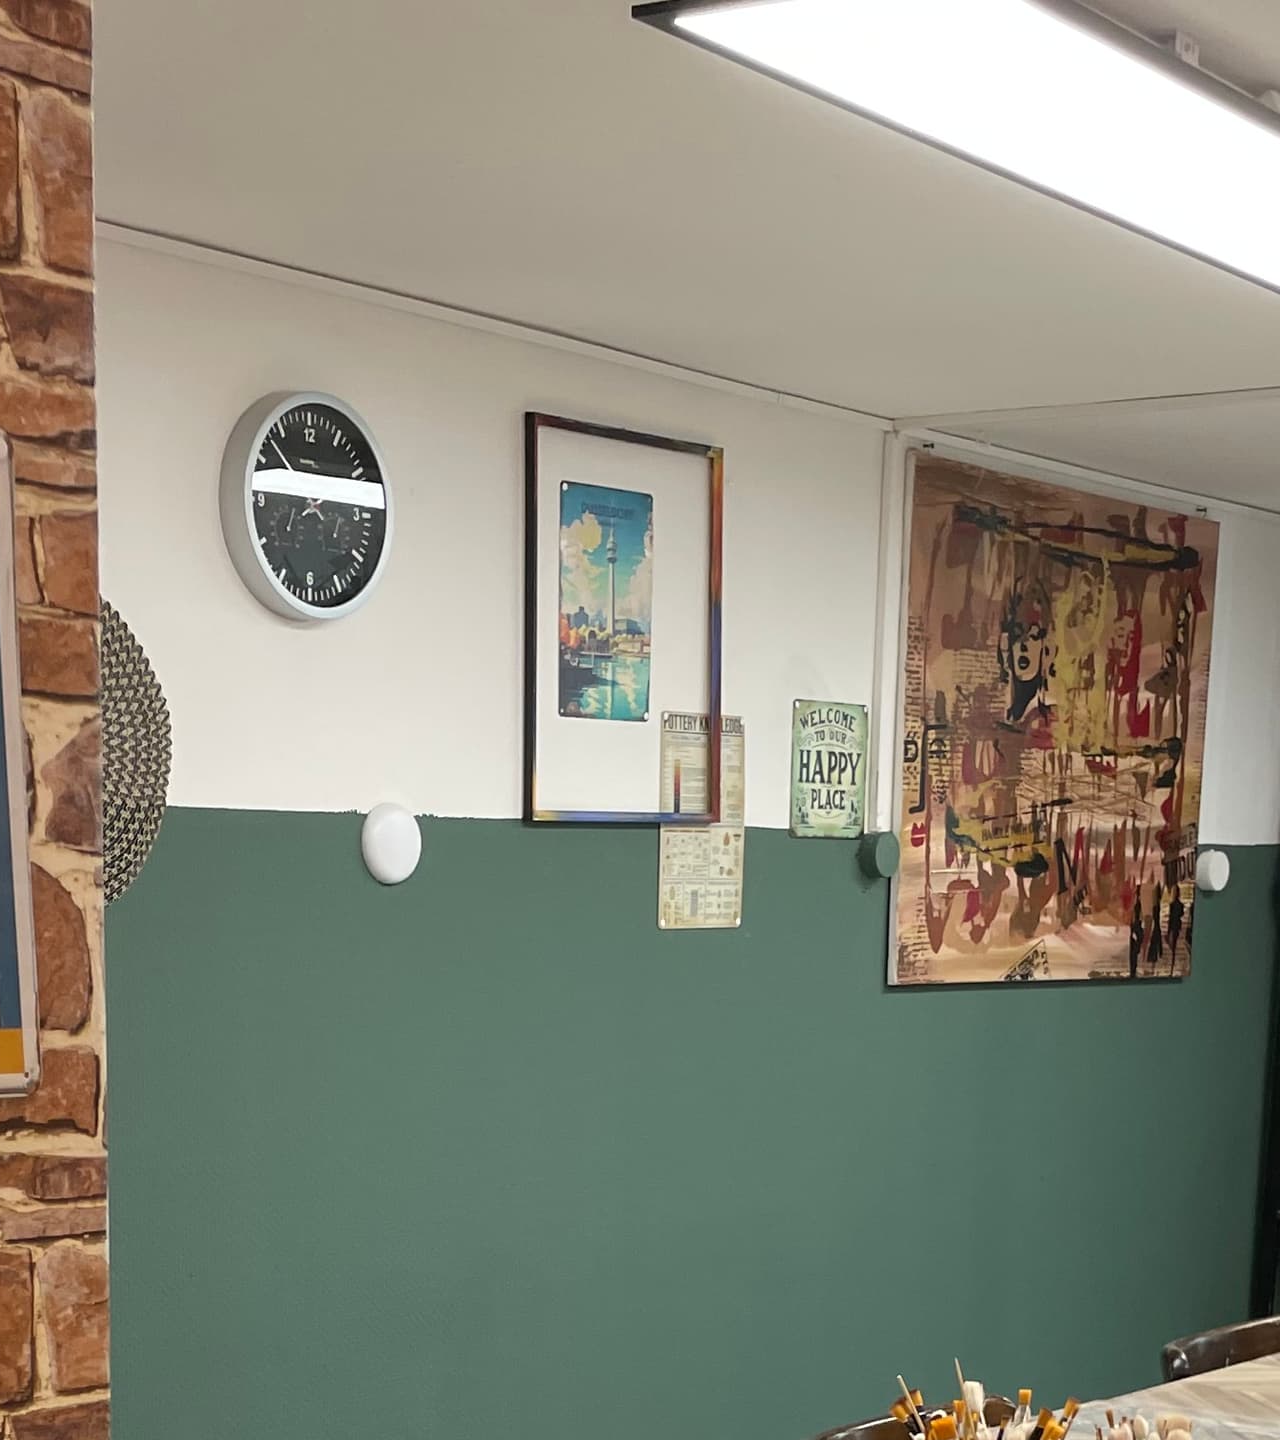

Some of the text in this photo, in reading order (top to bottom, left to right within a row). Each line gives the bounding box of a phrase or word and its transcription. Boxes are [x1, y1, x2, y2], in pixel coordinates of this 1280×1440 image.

[303, 427, 316, 444] 12
[256, 493, 266, 508] 9
[352, 506, 361, 522] 3
[305, 571, 315, 586] 6
[799, 707, 857, 733] WELCOME
[813, 729, 847, 745] TO OUR
[798, 749, 862, 786] HAPPY
[810, 788, 847, 811] PLACE
